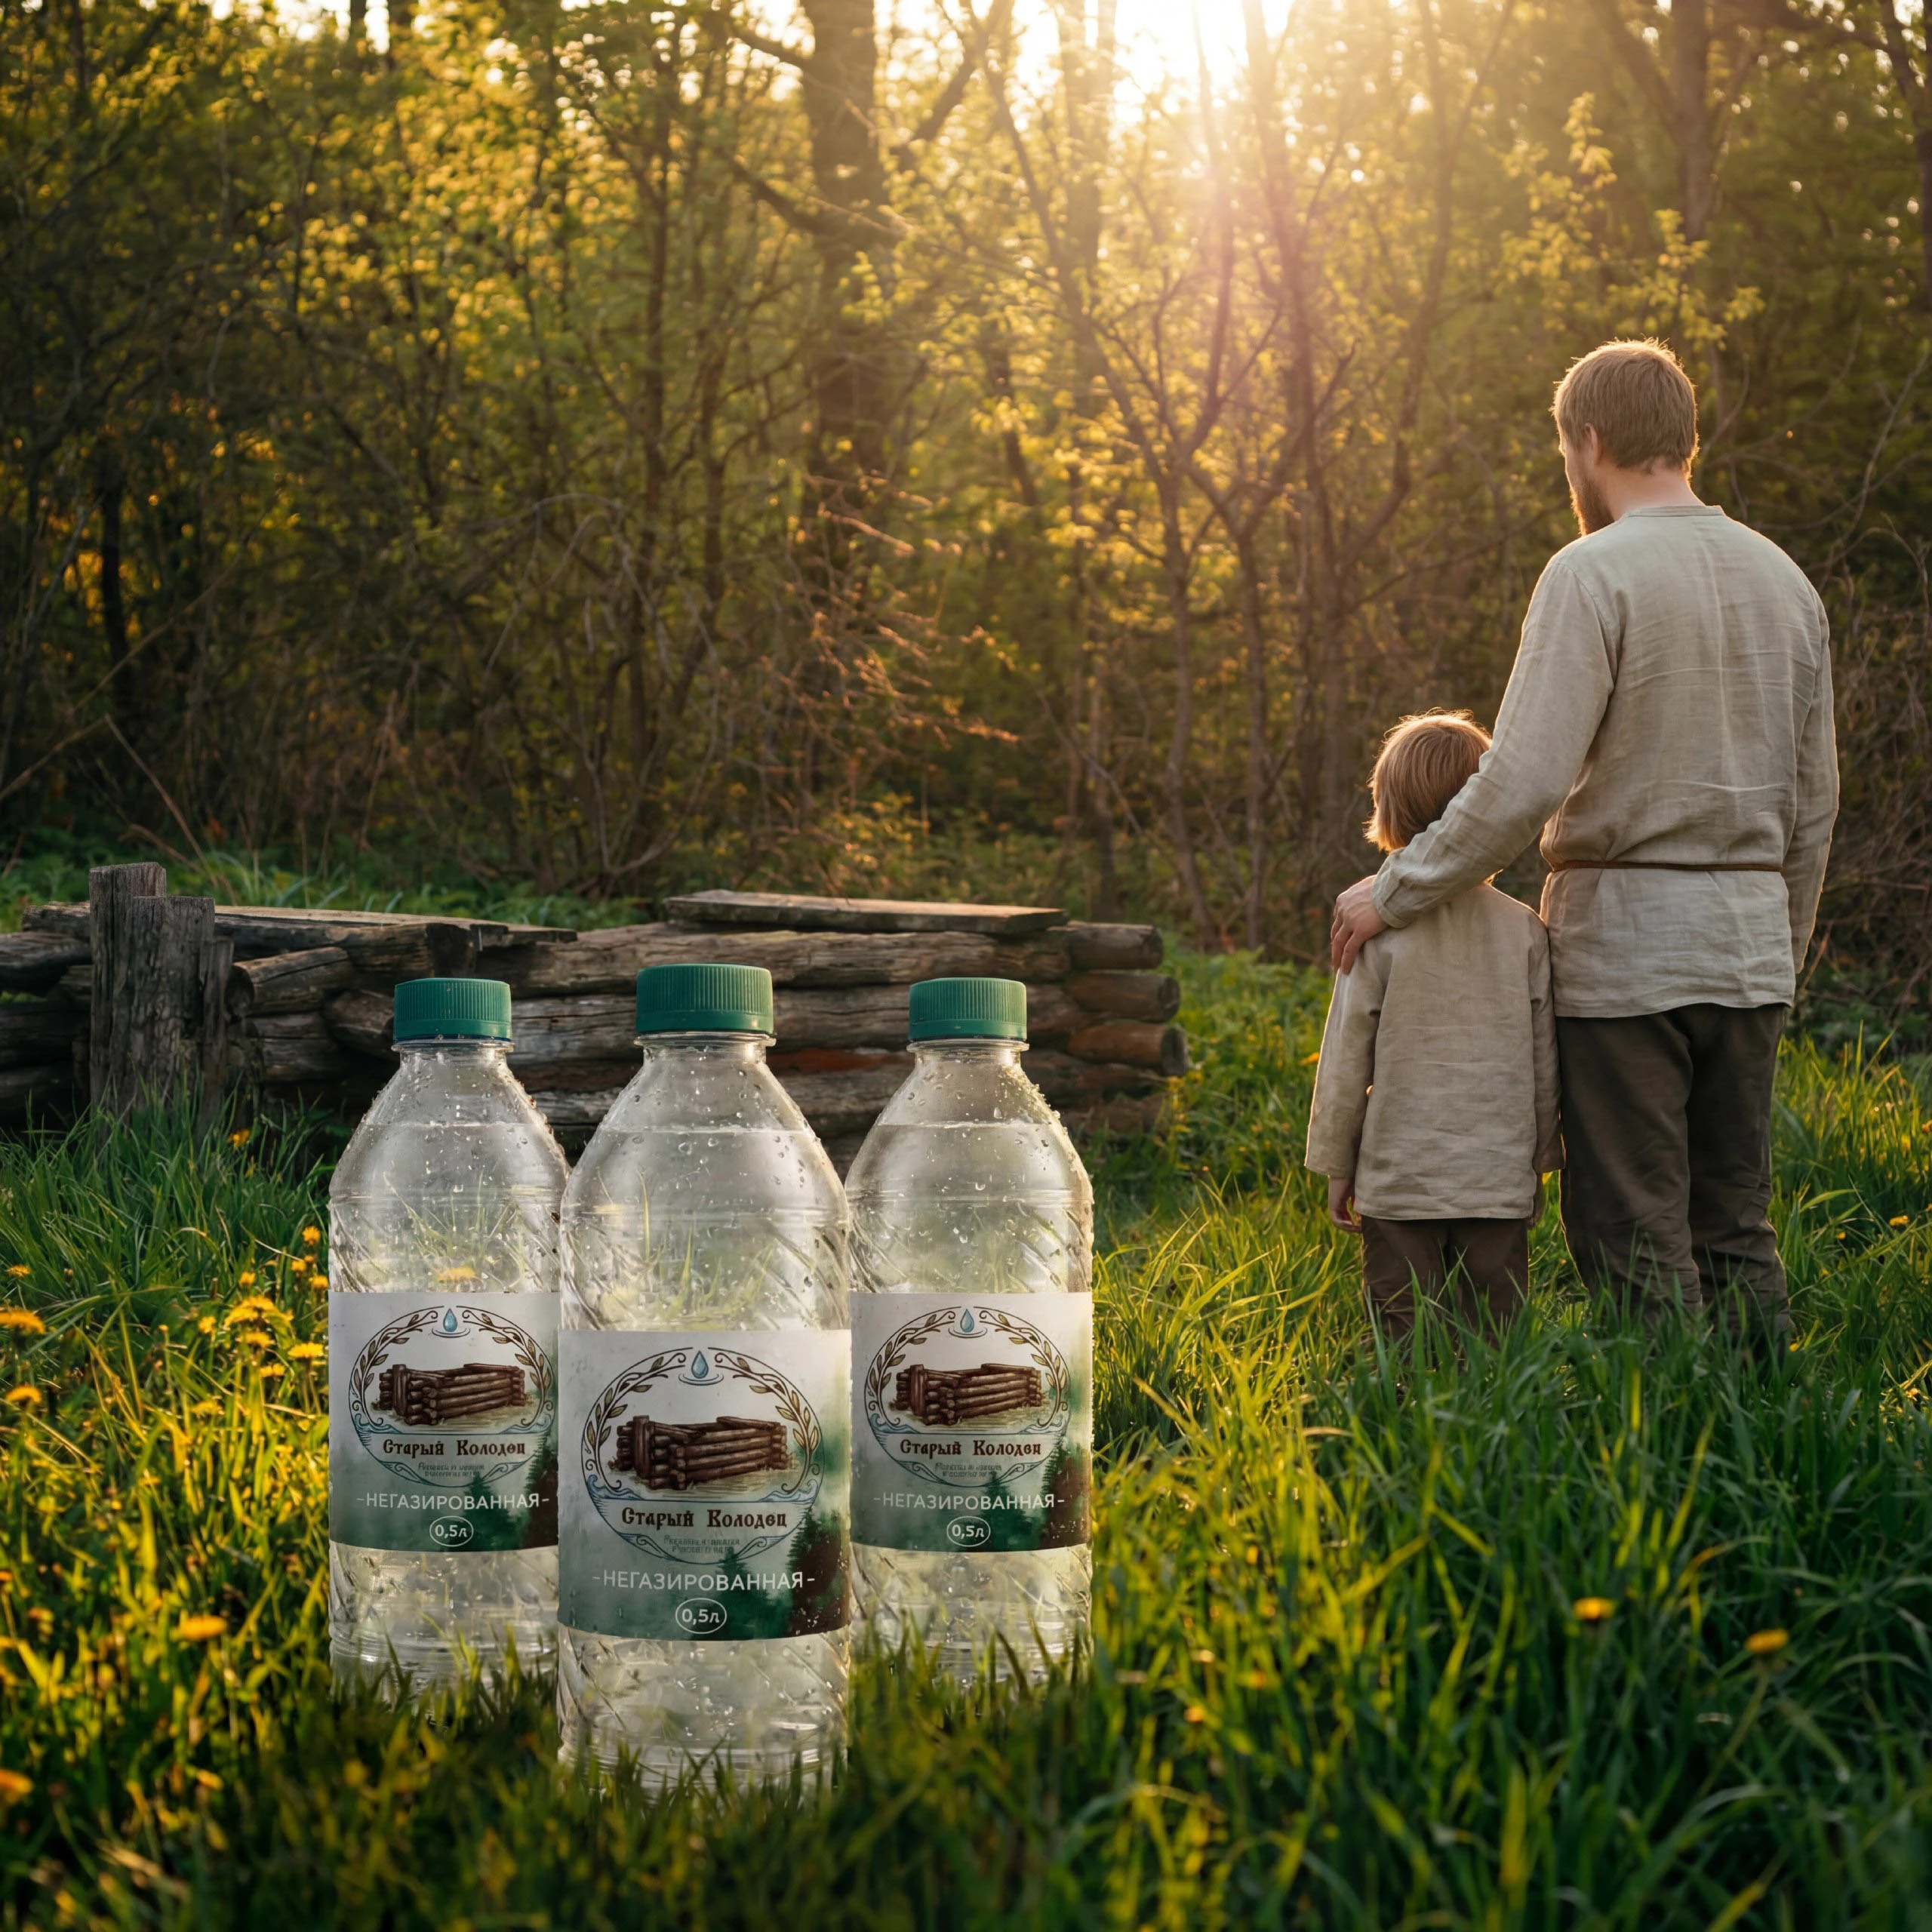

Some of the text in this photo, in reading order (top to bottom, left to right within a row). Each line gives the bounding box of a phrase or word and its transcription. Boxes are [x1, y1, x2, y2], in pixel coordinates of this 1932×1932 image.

[622, 1507, 787, 1531] Старый Колодец
[681, 1608, 720, 1625] 0,5л
